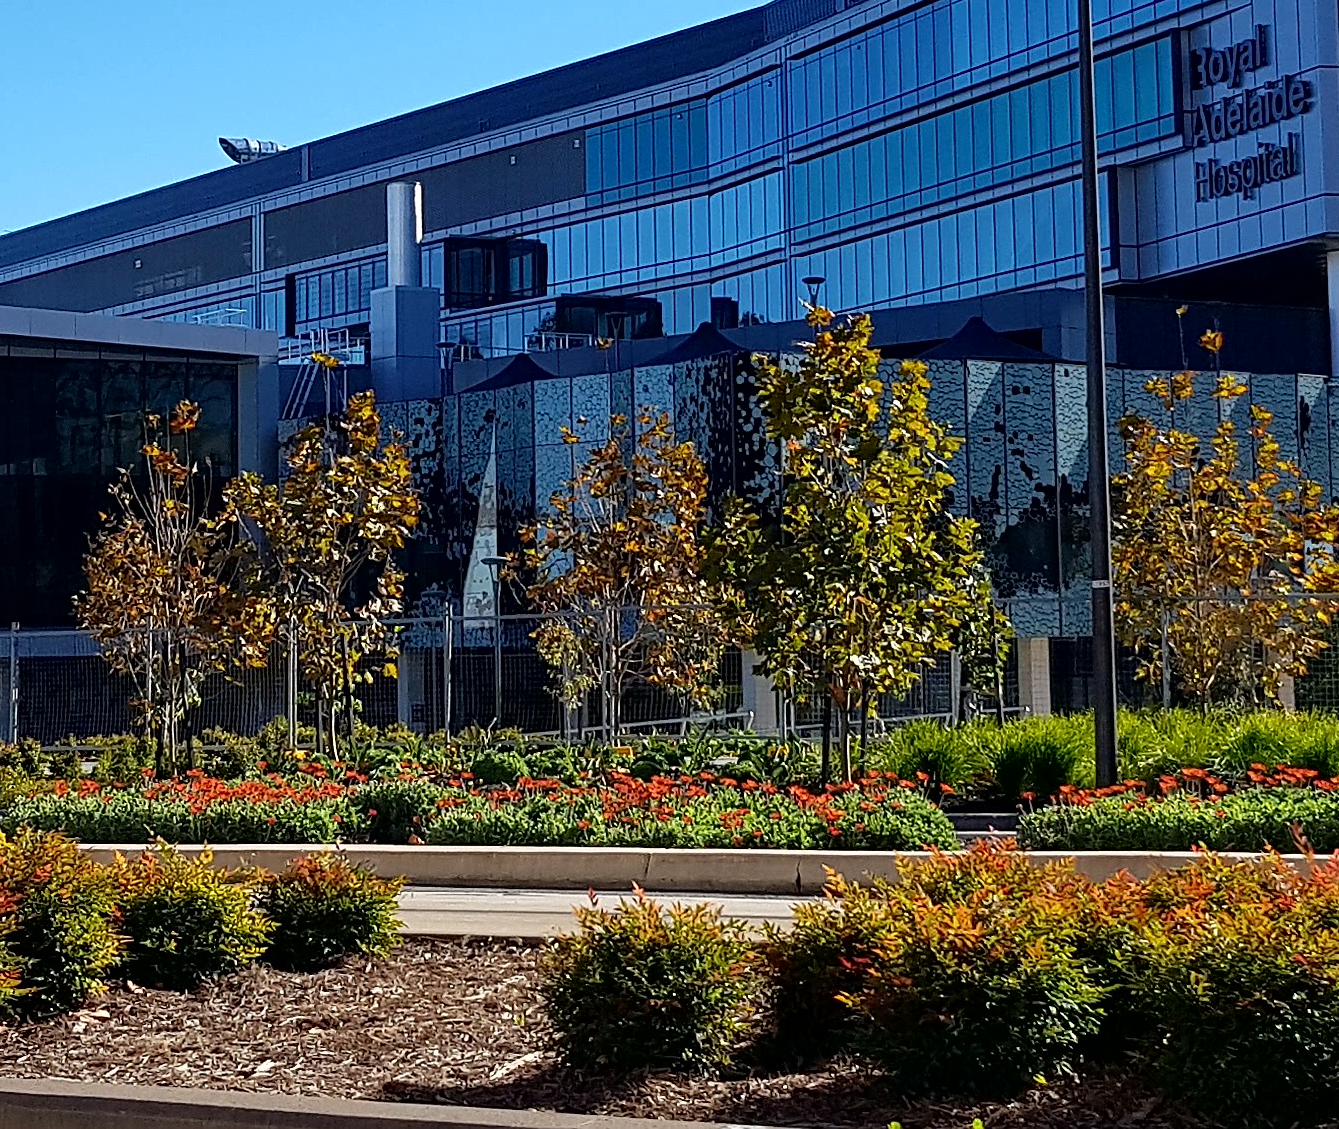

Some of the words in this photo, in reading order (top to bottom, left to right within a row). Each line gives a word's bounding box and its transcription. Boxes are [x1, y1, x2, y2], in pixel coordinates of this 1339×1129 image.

[1191, 24, 1269, 89] Royal
[1192, 75, 1313, 147] Adelaide
[1195, 132, 1300, 202] Hospital
